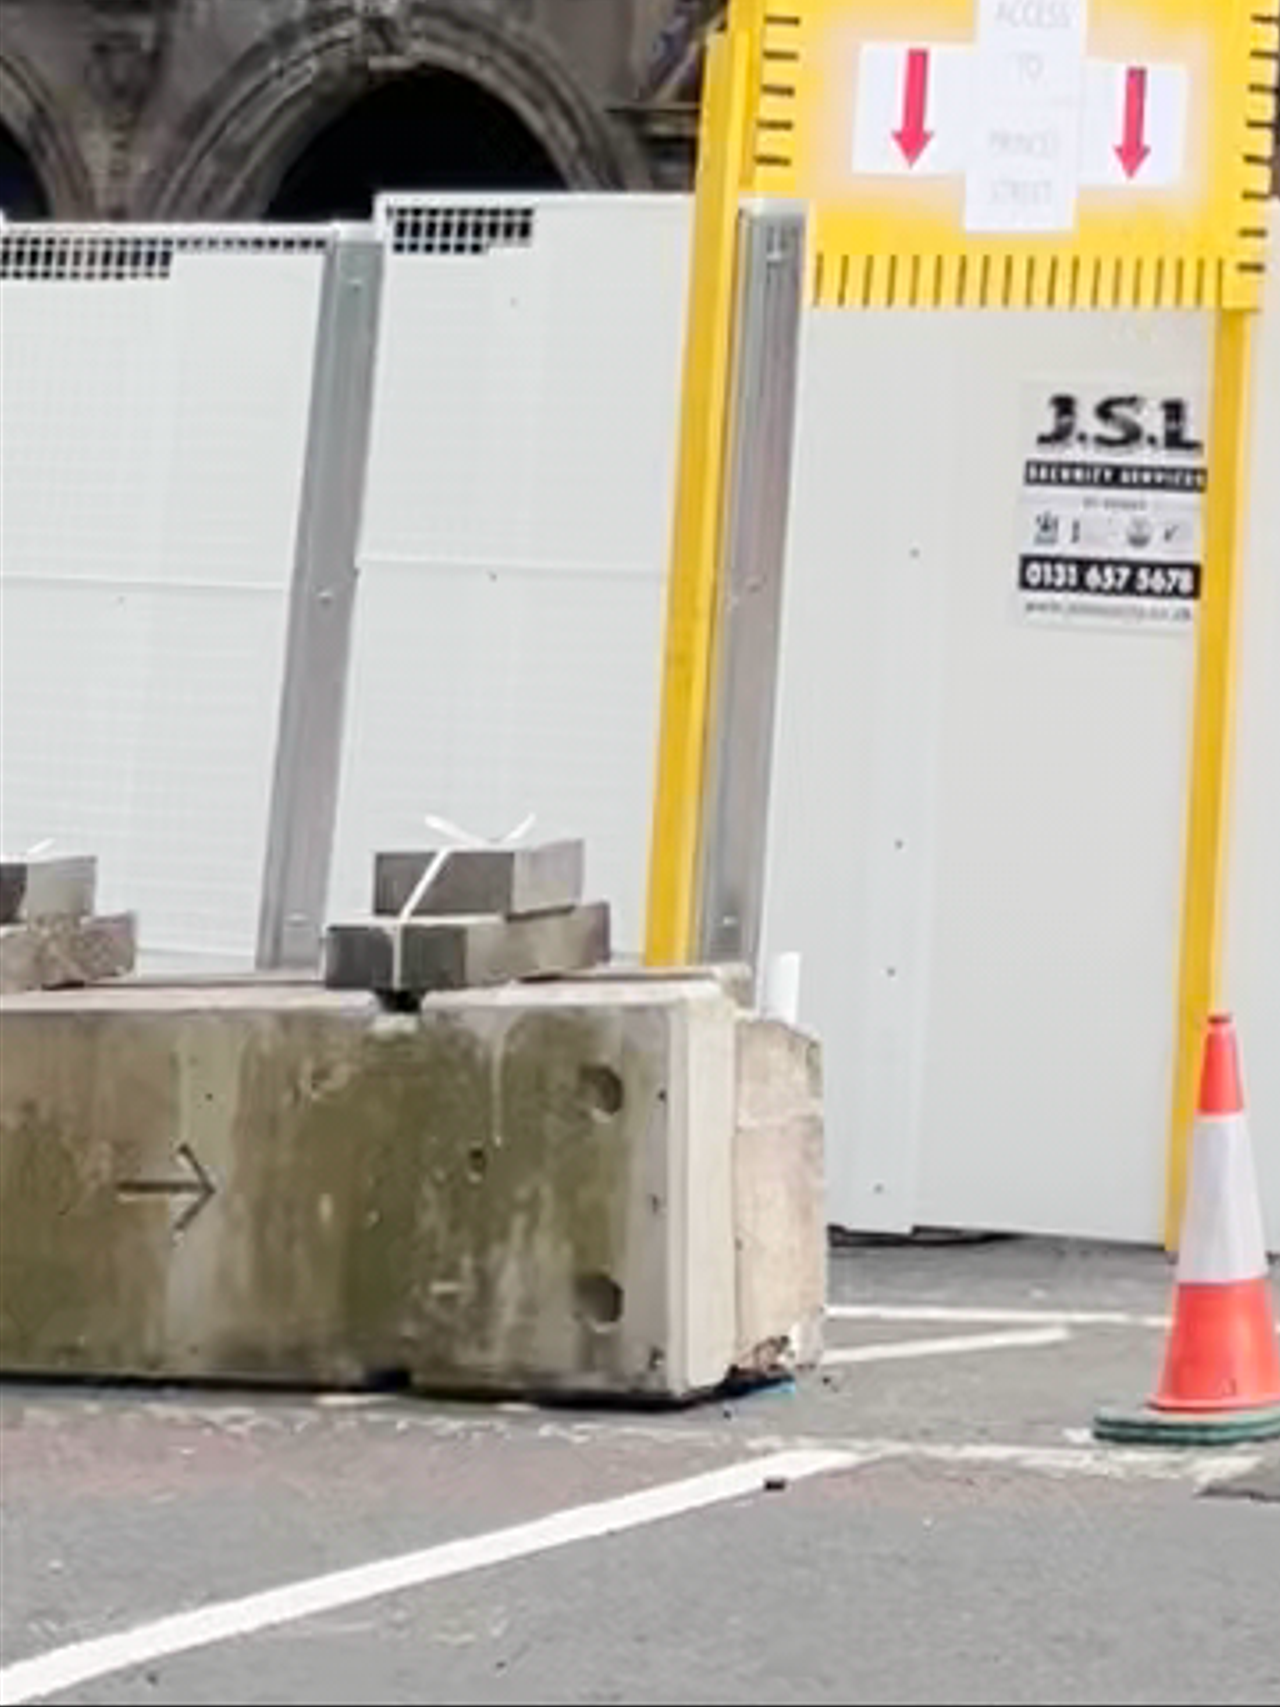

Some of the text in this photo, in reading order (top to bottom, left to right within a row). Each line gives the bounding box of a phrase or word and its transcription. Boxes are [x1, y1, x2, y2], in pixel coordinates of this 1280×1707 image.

[1026, 463, 1114, 483] SECURITY
[1025, 561, 1194, 595] 0131 657 5678
